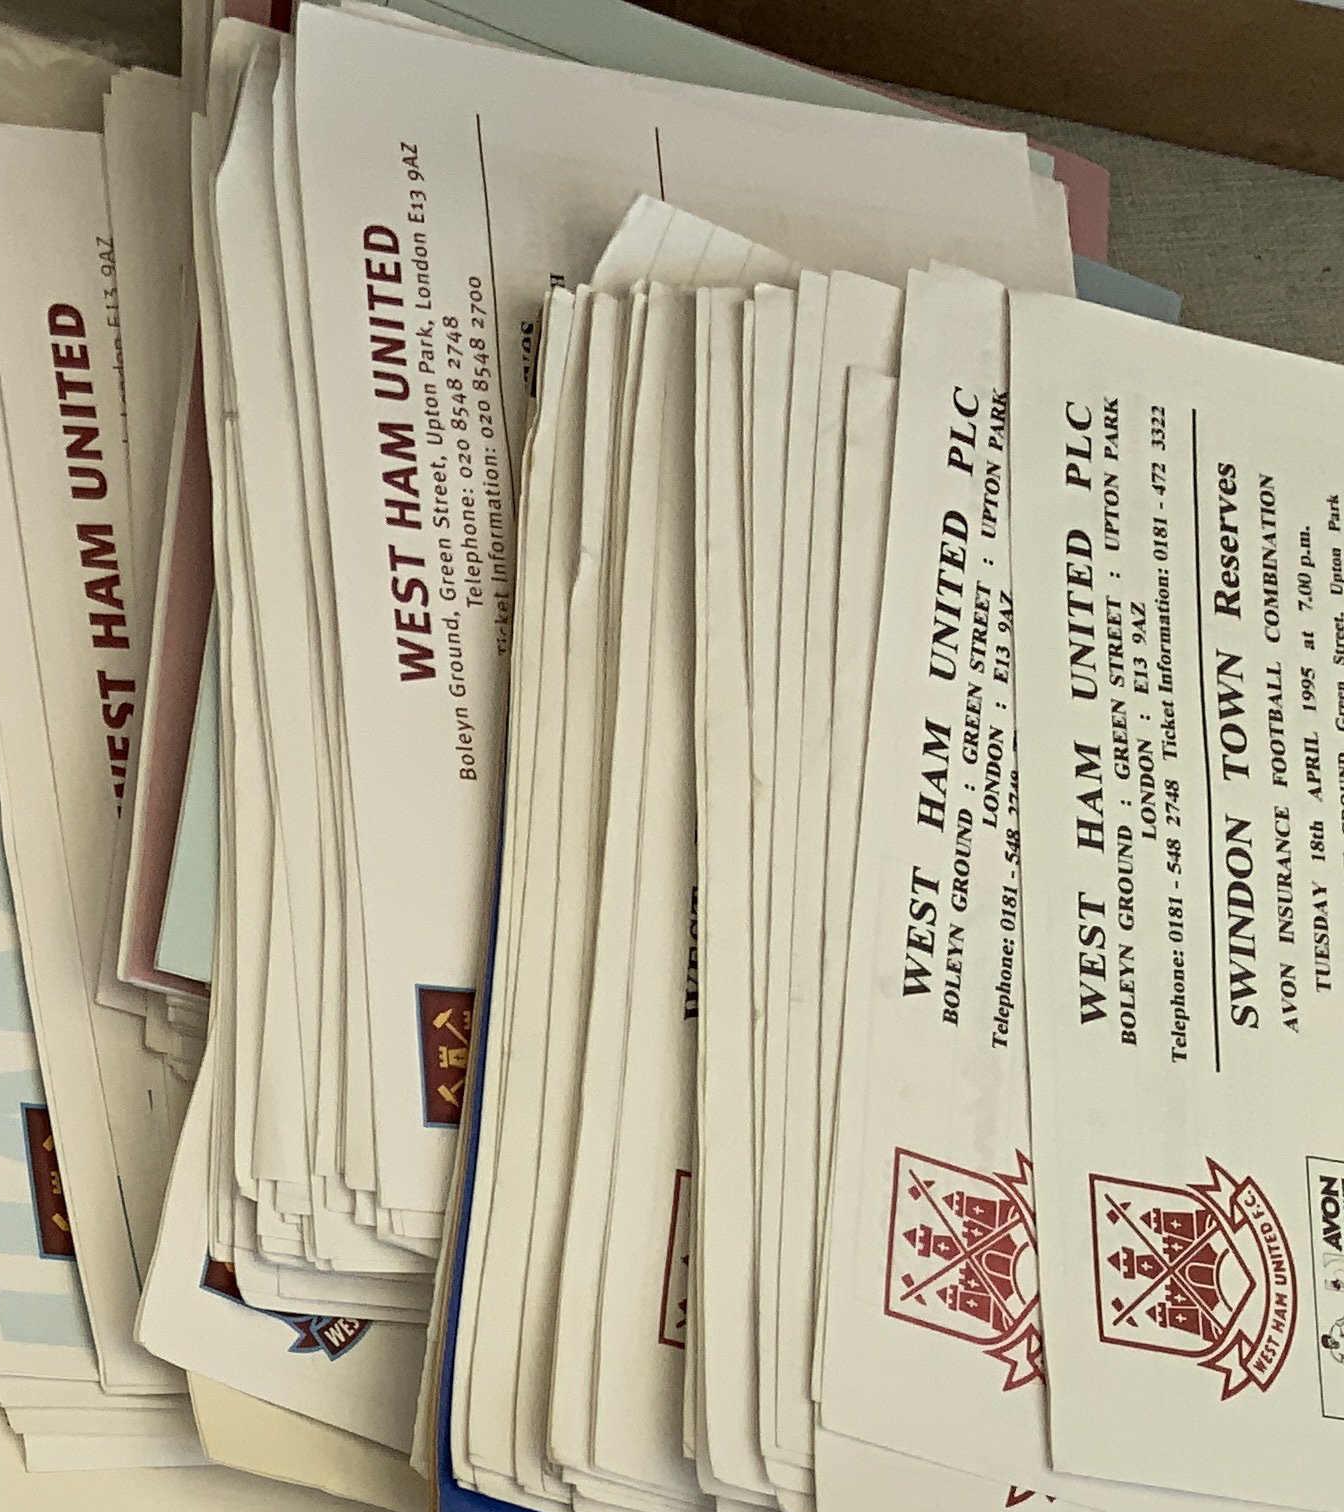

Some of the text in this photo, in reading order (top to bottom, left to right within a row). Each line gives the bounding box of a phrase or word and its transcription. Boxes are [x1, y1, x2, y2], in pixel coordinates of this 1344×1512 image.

[363, 225, 436, 681] WEST HAM UNITED
[400, 142, 477, 782] Boleyn Ground, Green Street, Upton Park, London E13 9AZ
[443, 315, 484, 609] Telephone: 020 8548 2748
[1066, 401, 1107, 1024] WEST HAM UNITED PLC
[1104, 398, 1137, 1045] BOLEYN GROUND GREEN STREET UPTON PARK
[1214, 463, 1259, 1029] SWINDON TOWN Reserves
[1259, 474, 1298, 1033] AVON INSURANCE FOOTBALL COMBINATION
